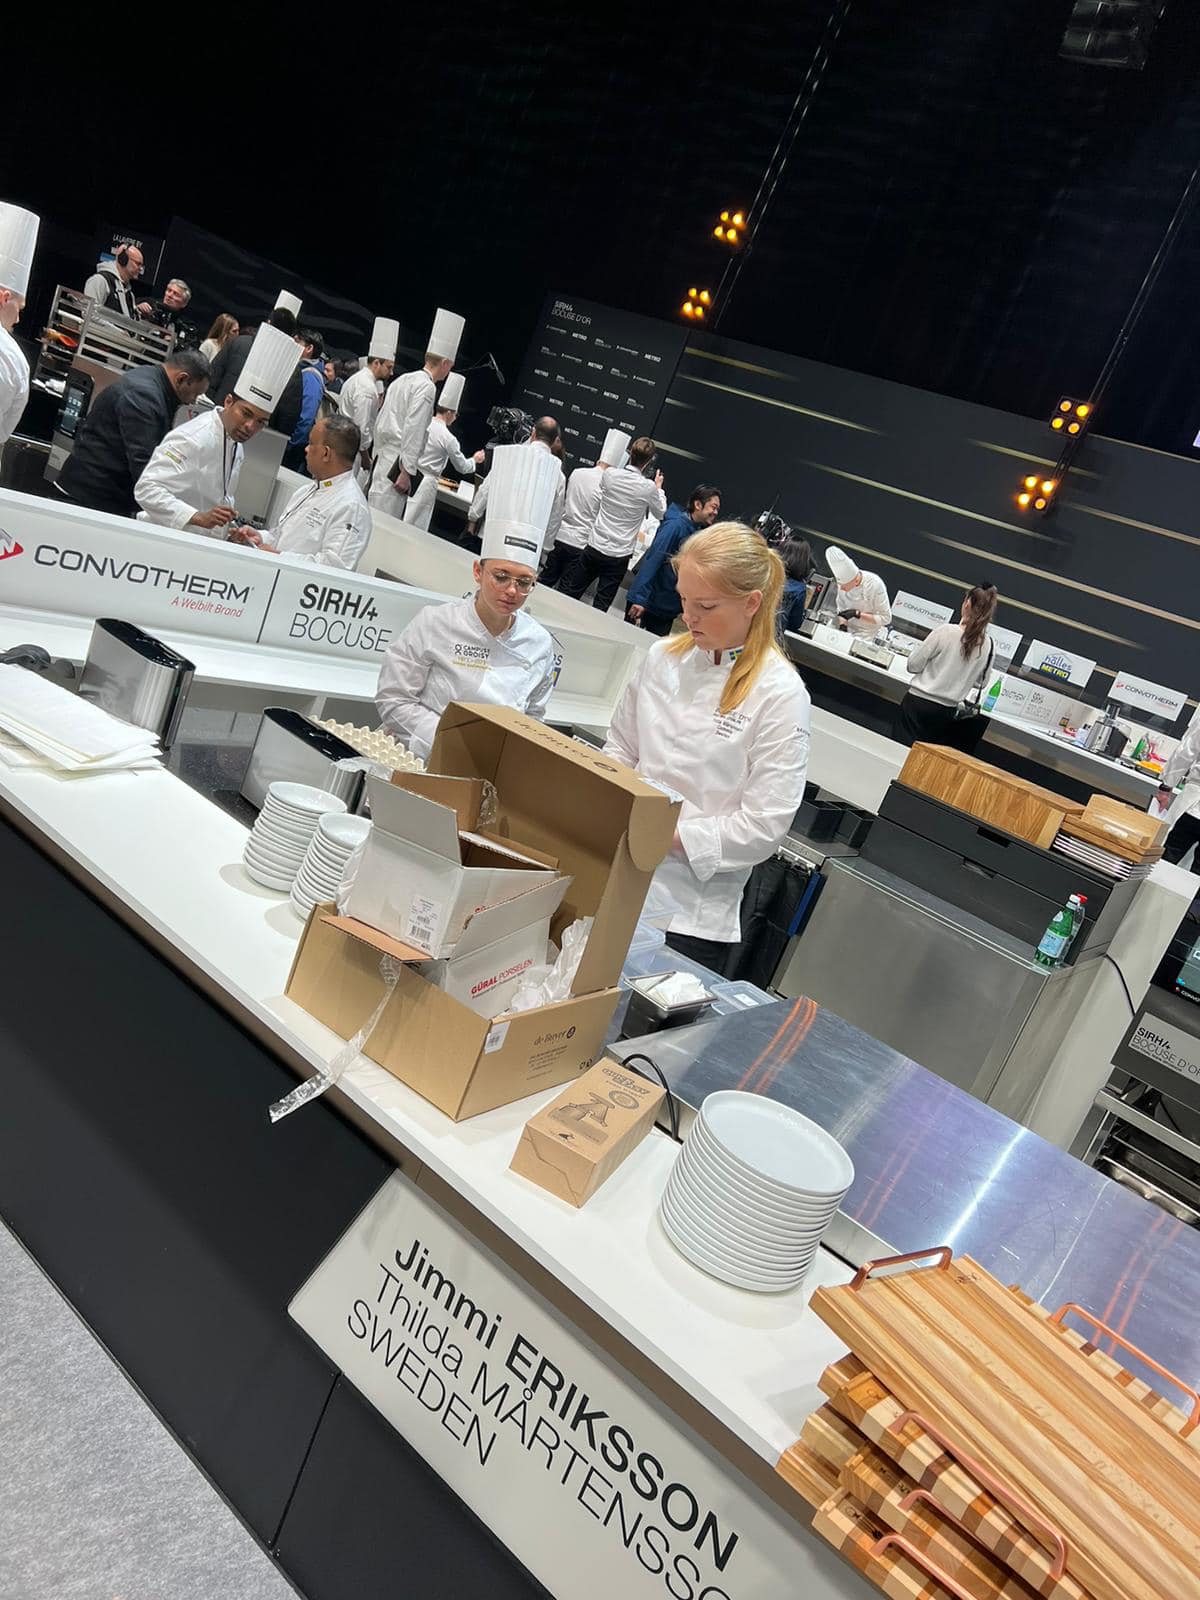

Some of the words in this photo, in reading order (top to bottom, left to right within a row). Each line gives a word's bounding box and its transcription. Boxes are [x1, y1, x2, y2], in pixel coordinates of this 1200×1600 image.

[34, 543, 251, 604] CONVOTHERM
[171, 596, 180, 607] A
[181, 597, 214, 614] Welbilt
[214, 603, 244, 618] Brand
[902, 601, 947, 621] CONVOTHERM
[289, 612, 393, 653] BOCUSE
[1040, 663, 1070, 679] METRO
[1124, 684, 1178, 707] CONVOTHERM
[1133, 1034, 1177, 1063] BOCUSE
[347, 1299, 497, 1467] SWEDEN
[395, 1239, 502, 1350] Jimmi
[504, 1333, 739, 1572] ERIKSSON
[376, 1263, 465, 1379] Thilda
[470, 1361, 731, 1600] MÅRTENSS
